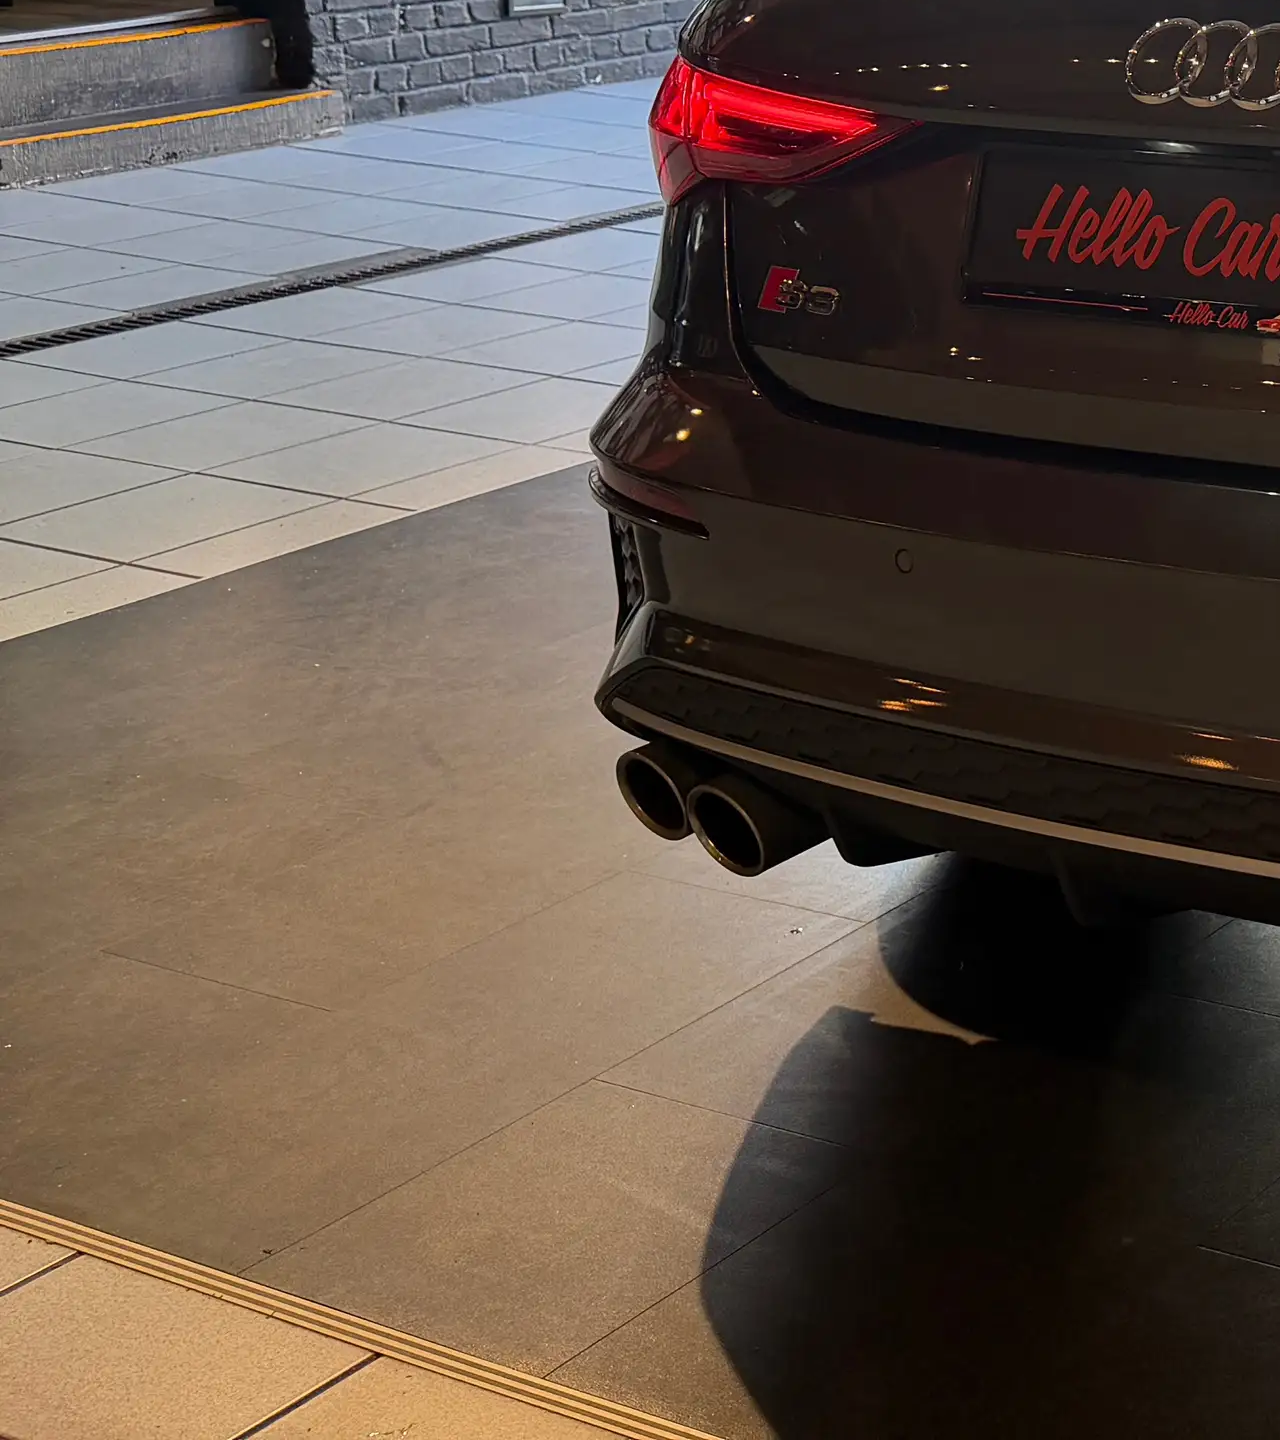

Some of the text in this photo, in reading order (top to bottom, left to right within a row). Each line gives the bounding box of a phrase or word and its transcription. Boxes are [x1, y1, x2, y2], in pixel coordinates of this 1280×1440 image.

[1016, 184, 1178, 269] Hello
[1163, 301, 1249, 330] Hello Car
